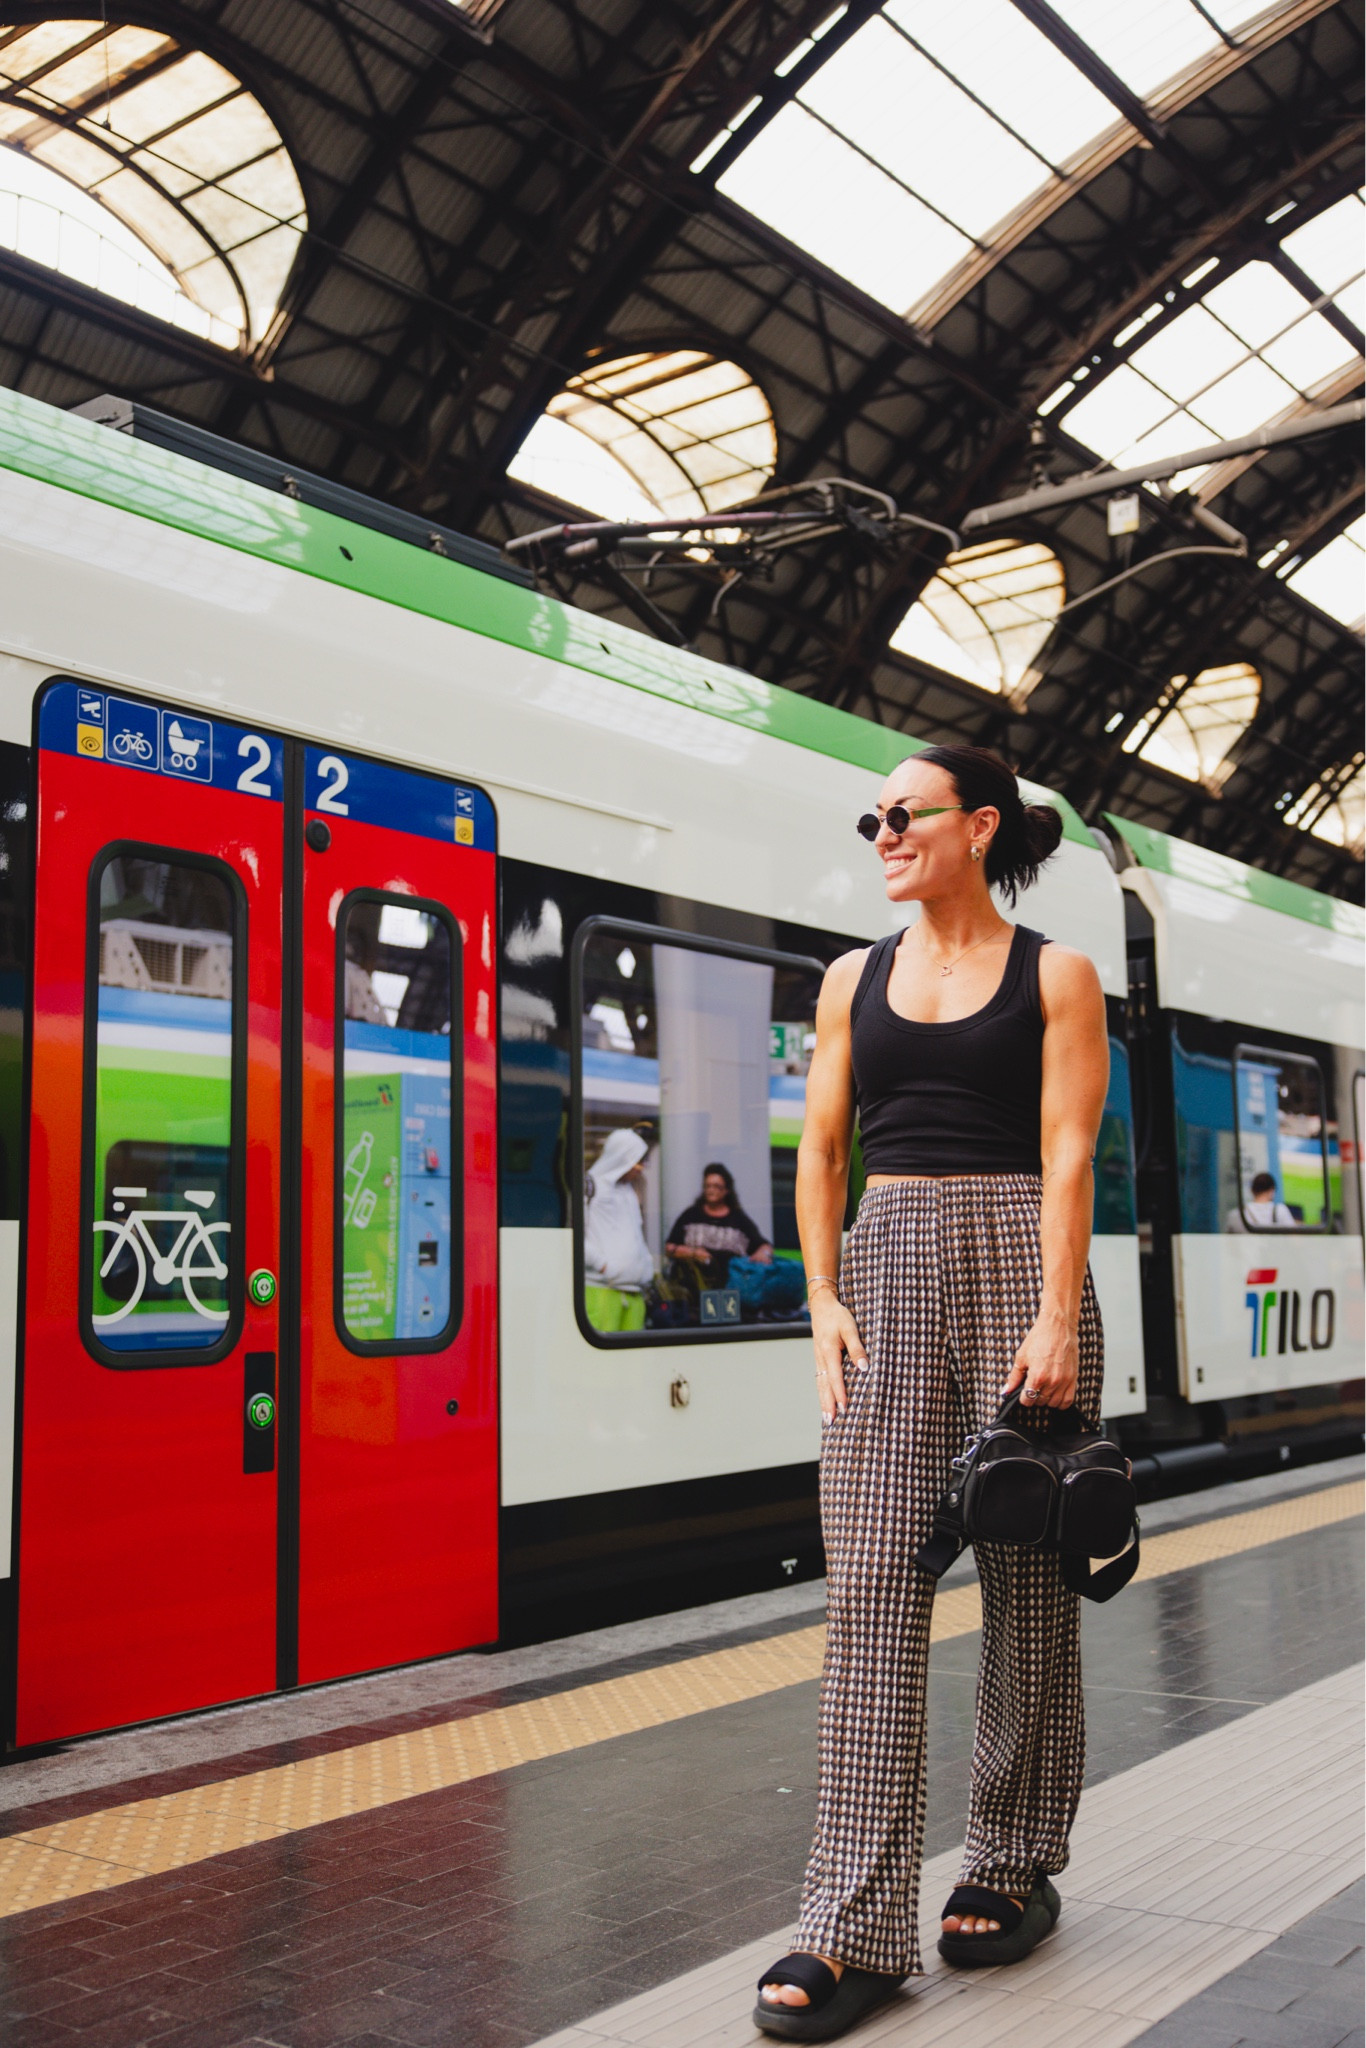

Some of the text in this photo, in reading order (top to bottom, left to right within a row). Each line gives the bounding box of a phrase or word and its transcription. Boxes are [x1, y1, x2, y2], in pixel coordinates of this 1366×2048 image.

[237, 735, 271, 797] 2
[317, 756, 349, 816] 2
[1245, 1268, 1335, 1358] TILO
